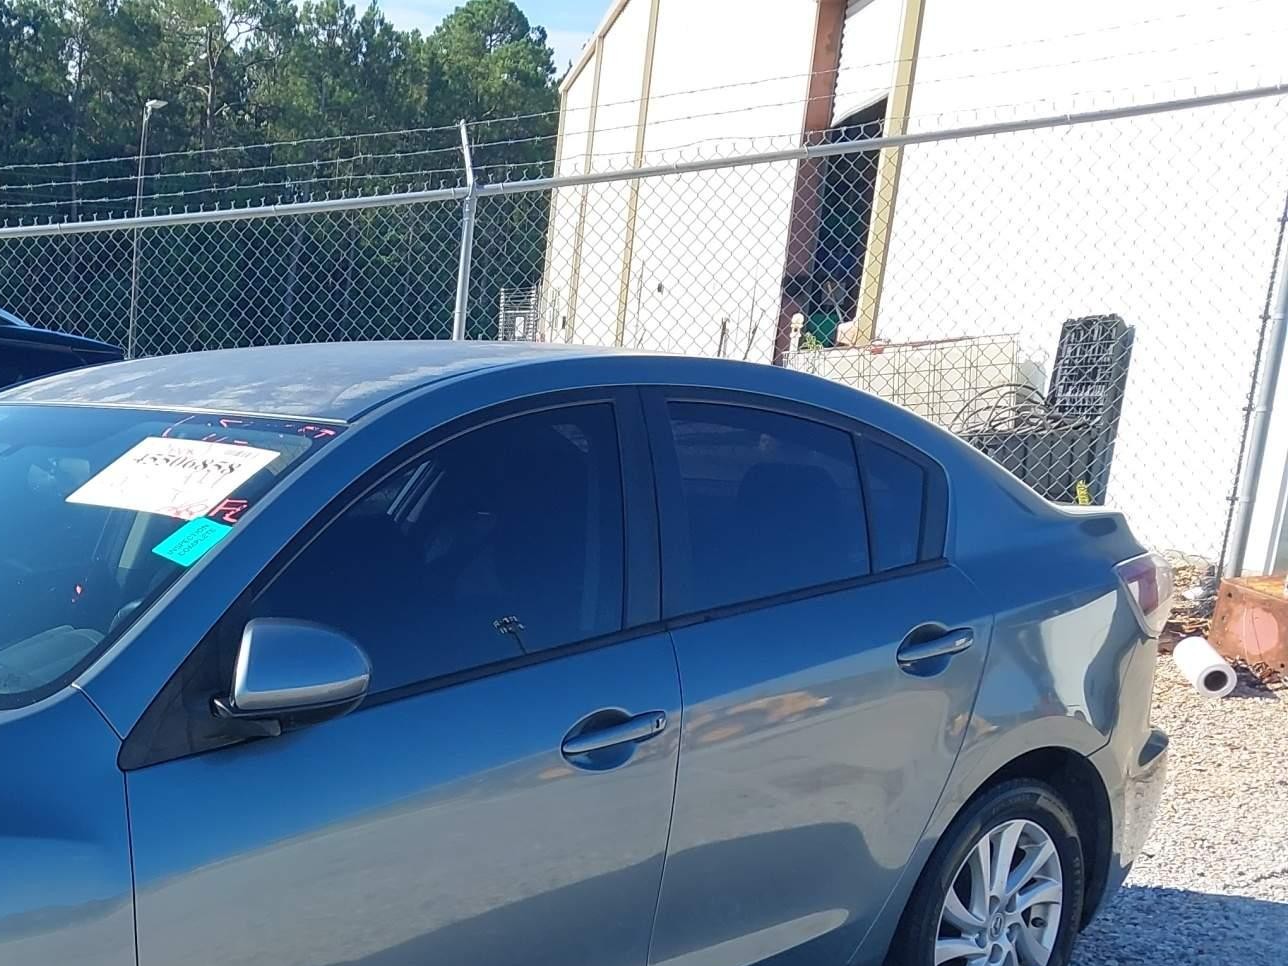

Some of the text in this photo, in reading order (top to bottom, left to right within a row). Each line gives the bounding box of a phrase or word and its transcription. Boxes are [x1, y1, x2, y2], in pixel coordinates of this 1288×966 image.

[133, 453, 242, 474] 45506858
[166, 523, 210, 557] INSPECTION
[177, 527, 218, 557] COMPLETE
